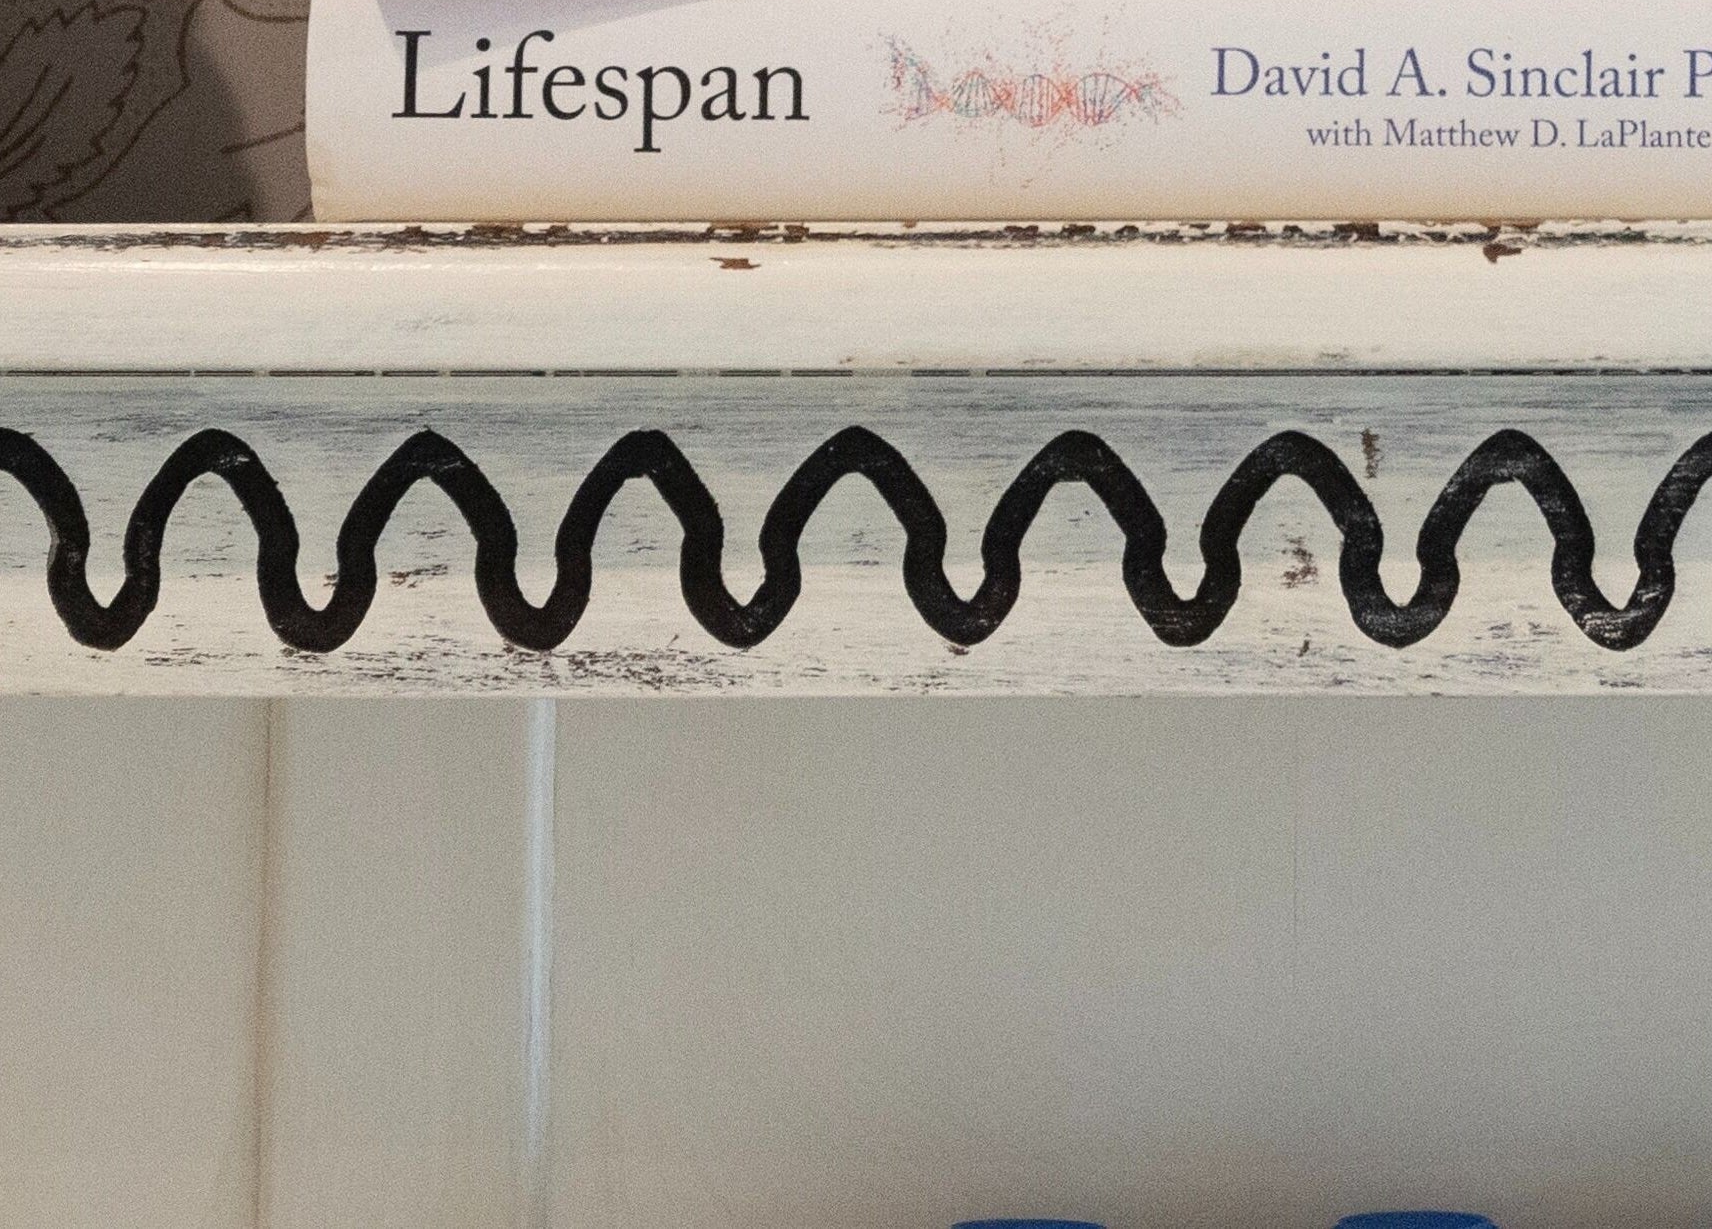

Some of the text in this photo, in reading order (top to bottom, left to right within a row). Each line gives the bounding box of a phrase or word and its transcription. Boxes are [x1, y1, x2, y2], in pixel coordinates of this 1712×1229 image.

[391, 29, 810, 153] Lifespan
[1210, 47, 1367, 99] David
[1386, 47, 1447, 99] A.
[1466, 47, 1665, 99] Sinclair
[1307, 119, 1712, 149] with Matthew D. LaPlante
